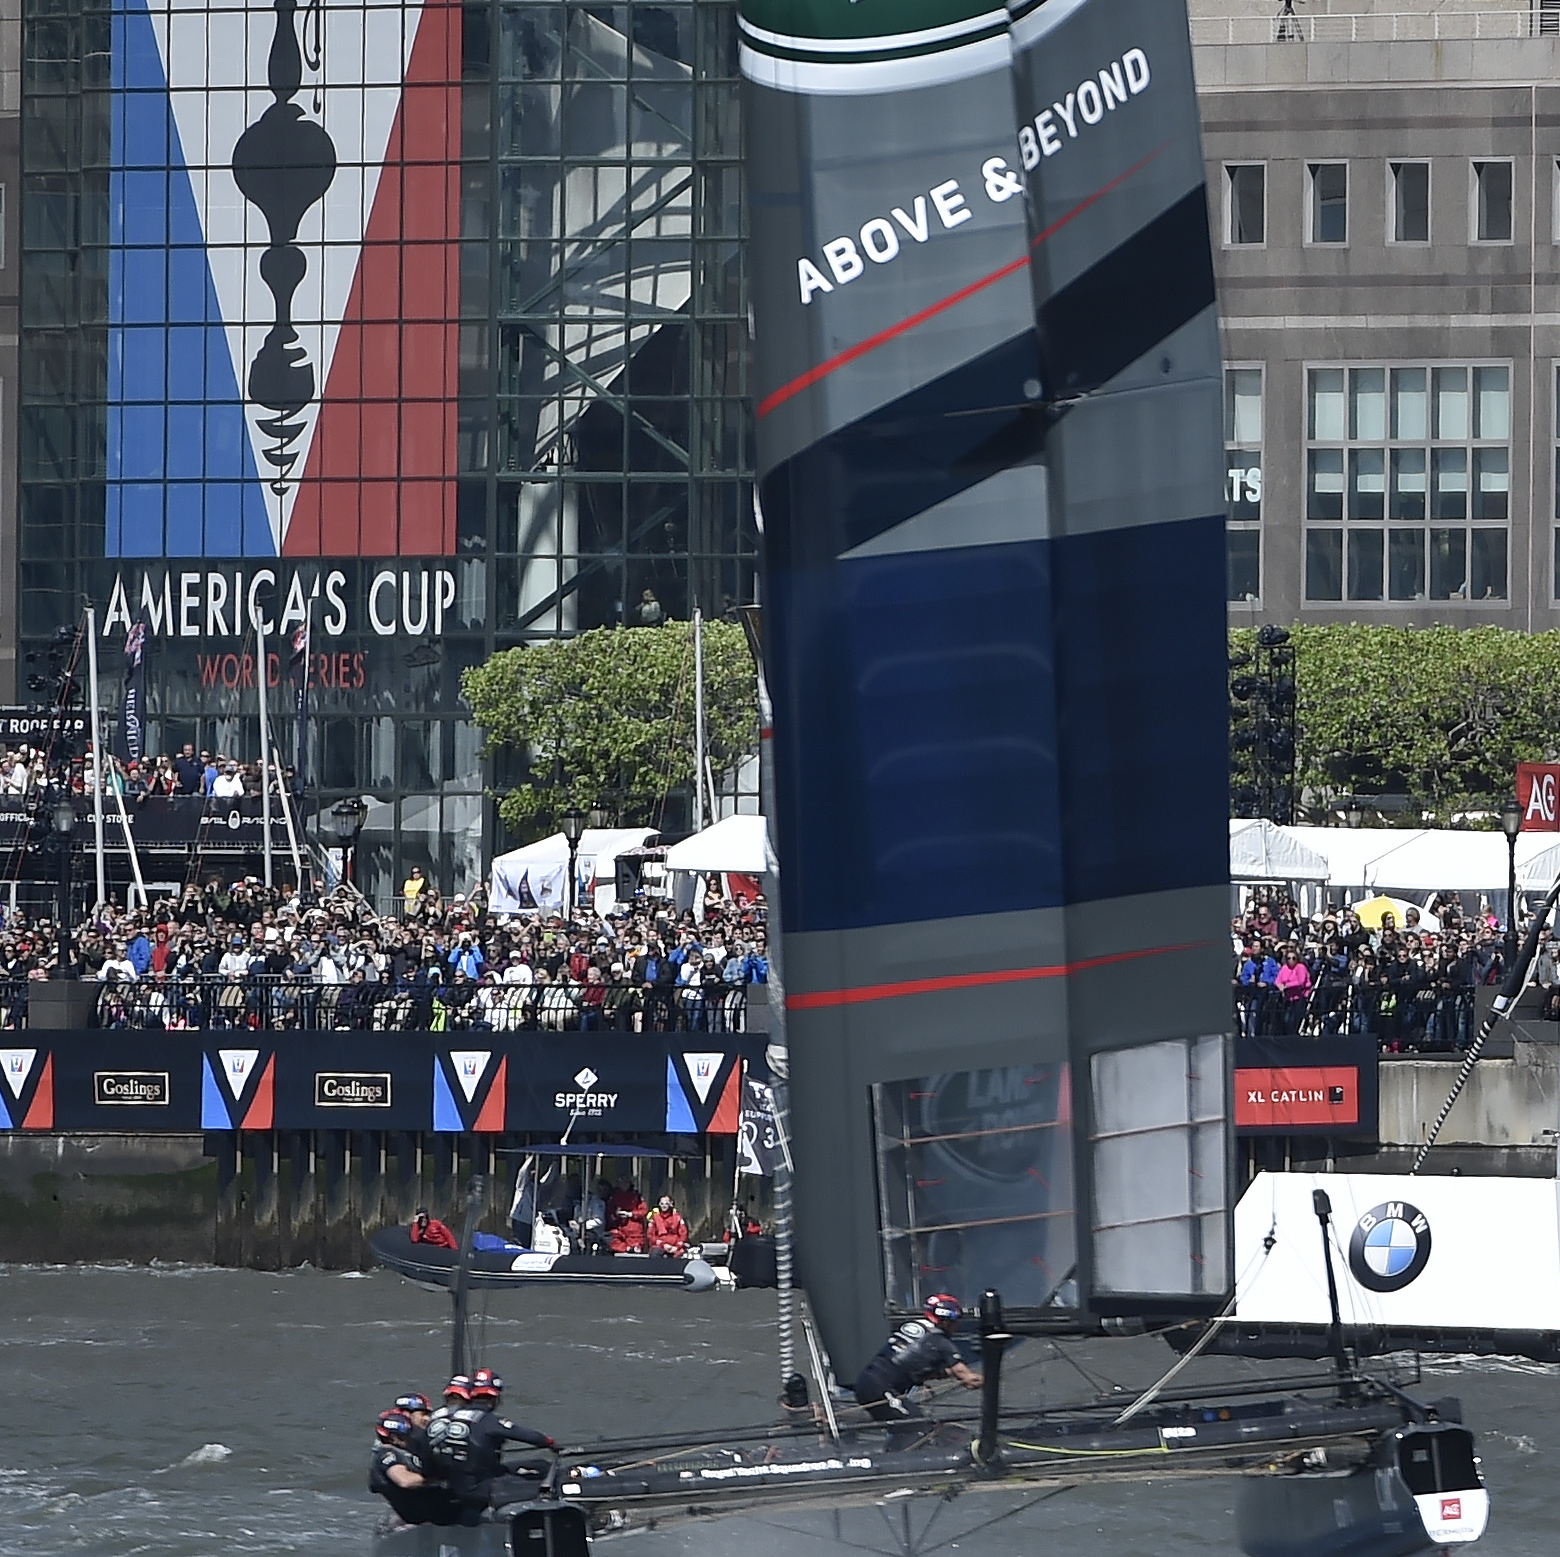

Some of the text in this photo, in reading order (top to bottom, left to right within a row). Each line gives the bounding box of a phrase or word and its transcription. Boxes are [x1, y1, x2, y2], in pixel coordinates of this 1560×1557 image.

[797, 48, 1152, 304] ABOVE & BEYOND
[102, 570, 456, 637] AMERICA'S CUP
[198, 653, 366, 689] WORD ERIES
[103, 1078, 161, 1101] Goslings
[323, 1079, 382, 1102] Goslings
[555, 1093, 618, 1108] SPERRY
[1247, 1090, 1324, 1103] XL CATLIN
[1359, 1202, 1428, 1233] BMW
